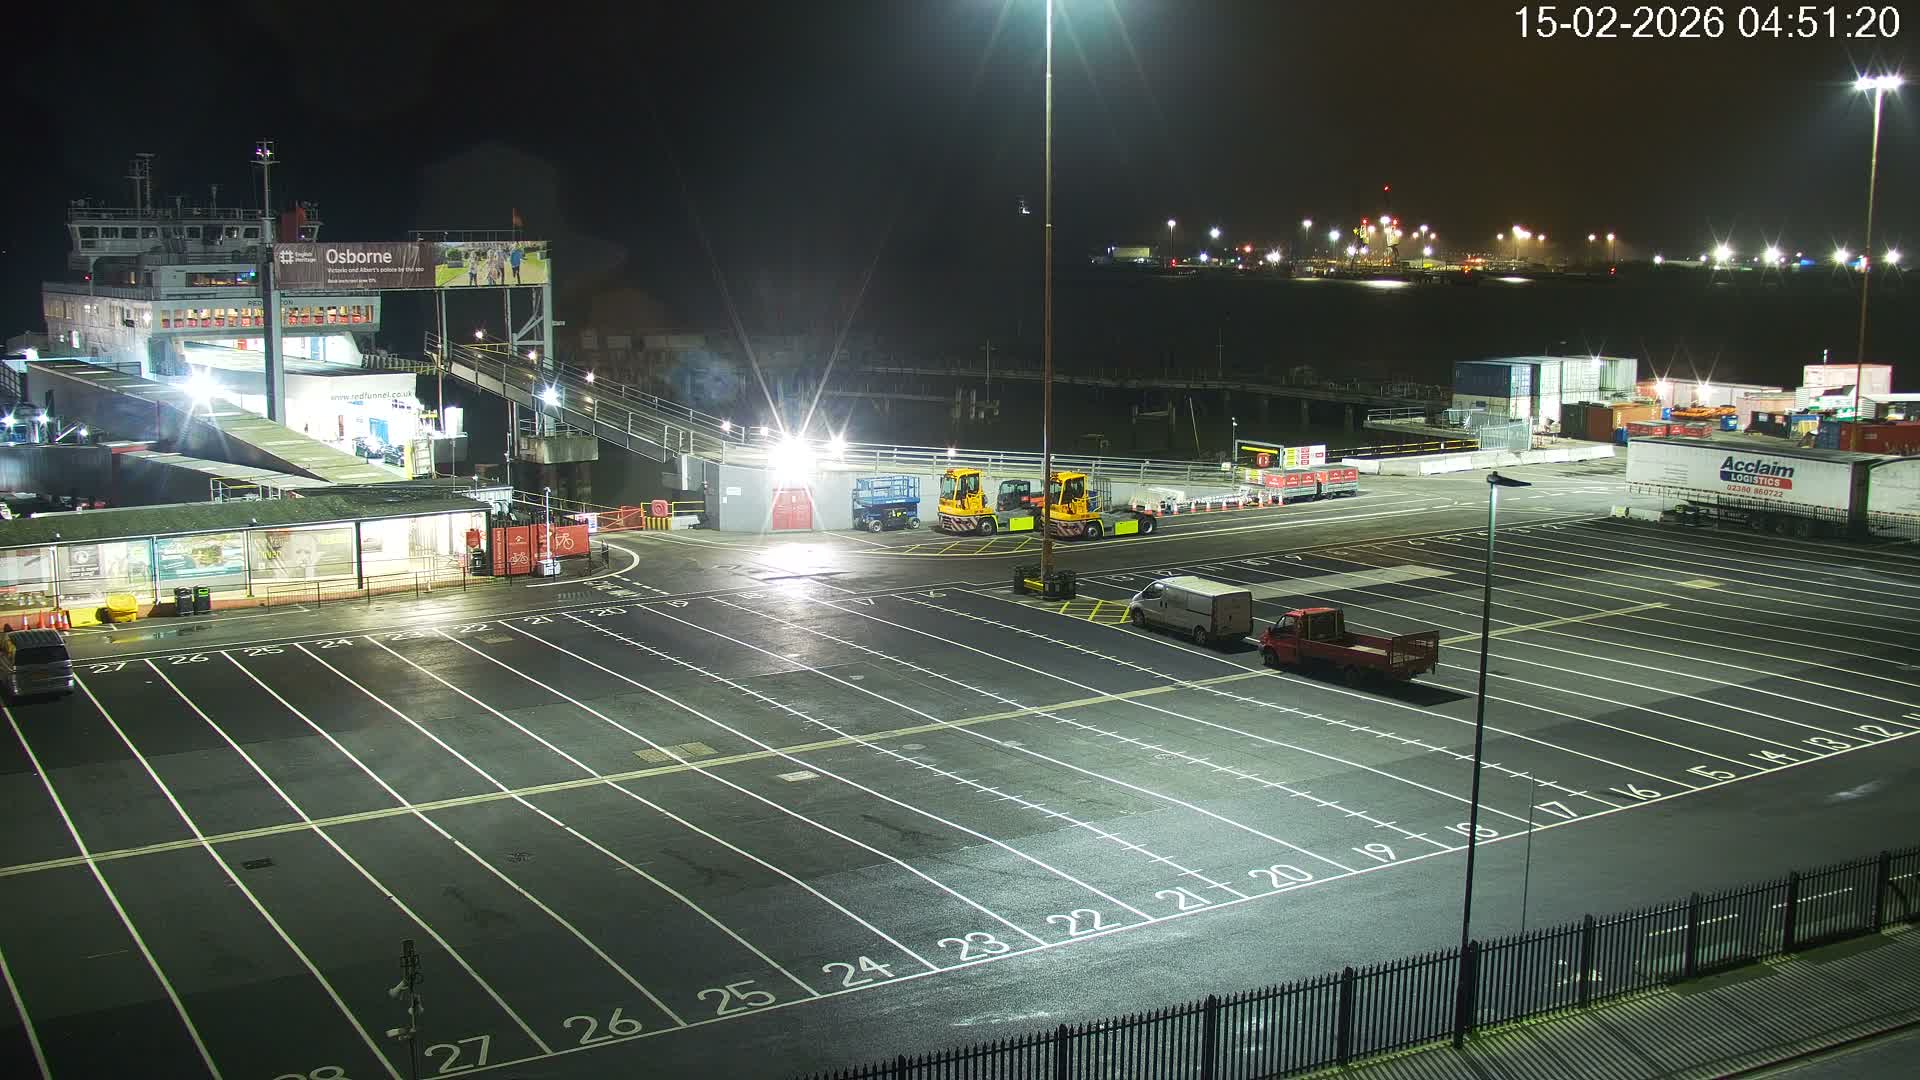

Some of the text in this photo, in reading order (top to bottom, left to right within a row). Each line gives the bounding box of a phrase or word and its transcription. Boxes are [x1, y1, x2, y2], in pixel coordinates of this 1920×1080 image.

[326, 249, 392, 264] Osborne
[330, 391, 412, 401] www.redfunnel.co.uk
[1720, 456, 1795, 478] Acclaim
[1731, 474, 1781, 487] LOGISTICS
[524, 615, 554, 625] 21
[590, 606, 628, 617] 20
[385, 631, 426, 641] 23
[453, 622, 494, 633] 22
[243, 645, 286, 657] 25
[316, 637, 354, 649] 24
[167, 652, 209, 665] 26
[89, 661, 128, 674] 27
[1853, 724, 1904, 738] 12
[1802, 735, 1853, 751] 13
[1748, 749, 1800, 765] 14
[1687, 764, 1737, 782] 15
[1608, 782, 1662, 801] 16
[1533, 800, 1580, 820] 17
[1444, 822, 1499, 841] 18
[1351, 842, 1398, 863] 19
[1247, 863, 1314, 889] 20
[1154, 886, 1215, 912] 21
[1046, 908, 1121, 938] 22
[938, 931, 1010, 962] 23
[822, 954, 896, 988] 24
[697, 979, 776, 1016] 25
[562, 1007, 644, 1045] 26
[424, 1034, 493, 1075] 27
